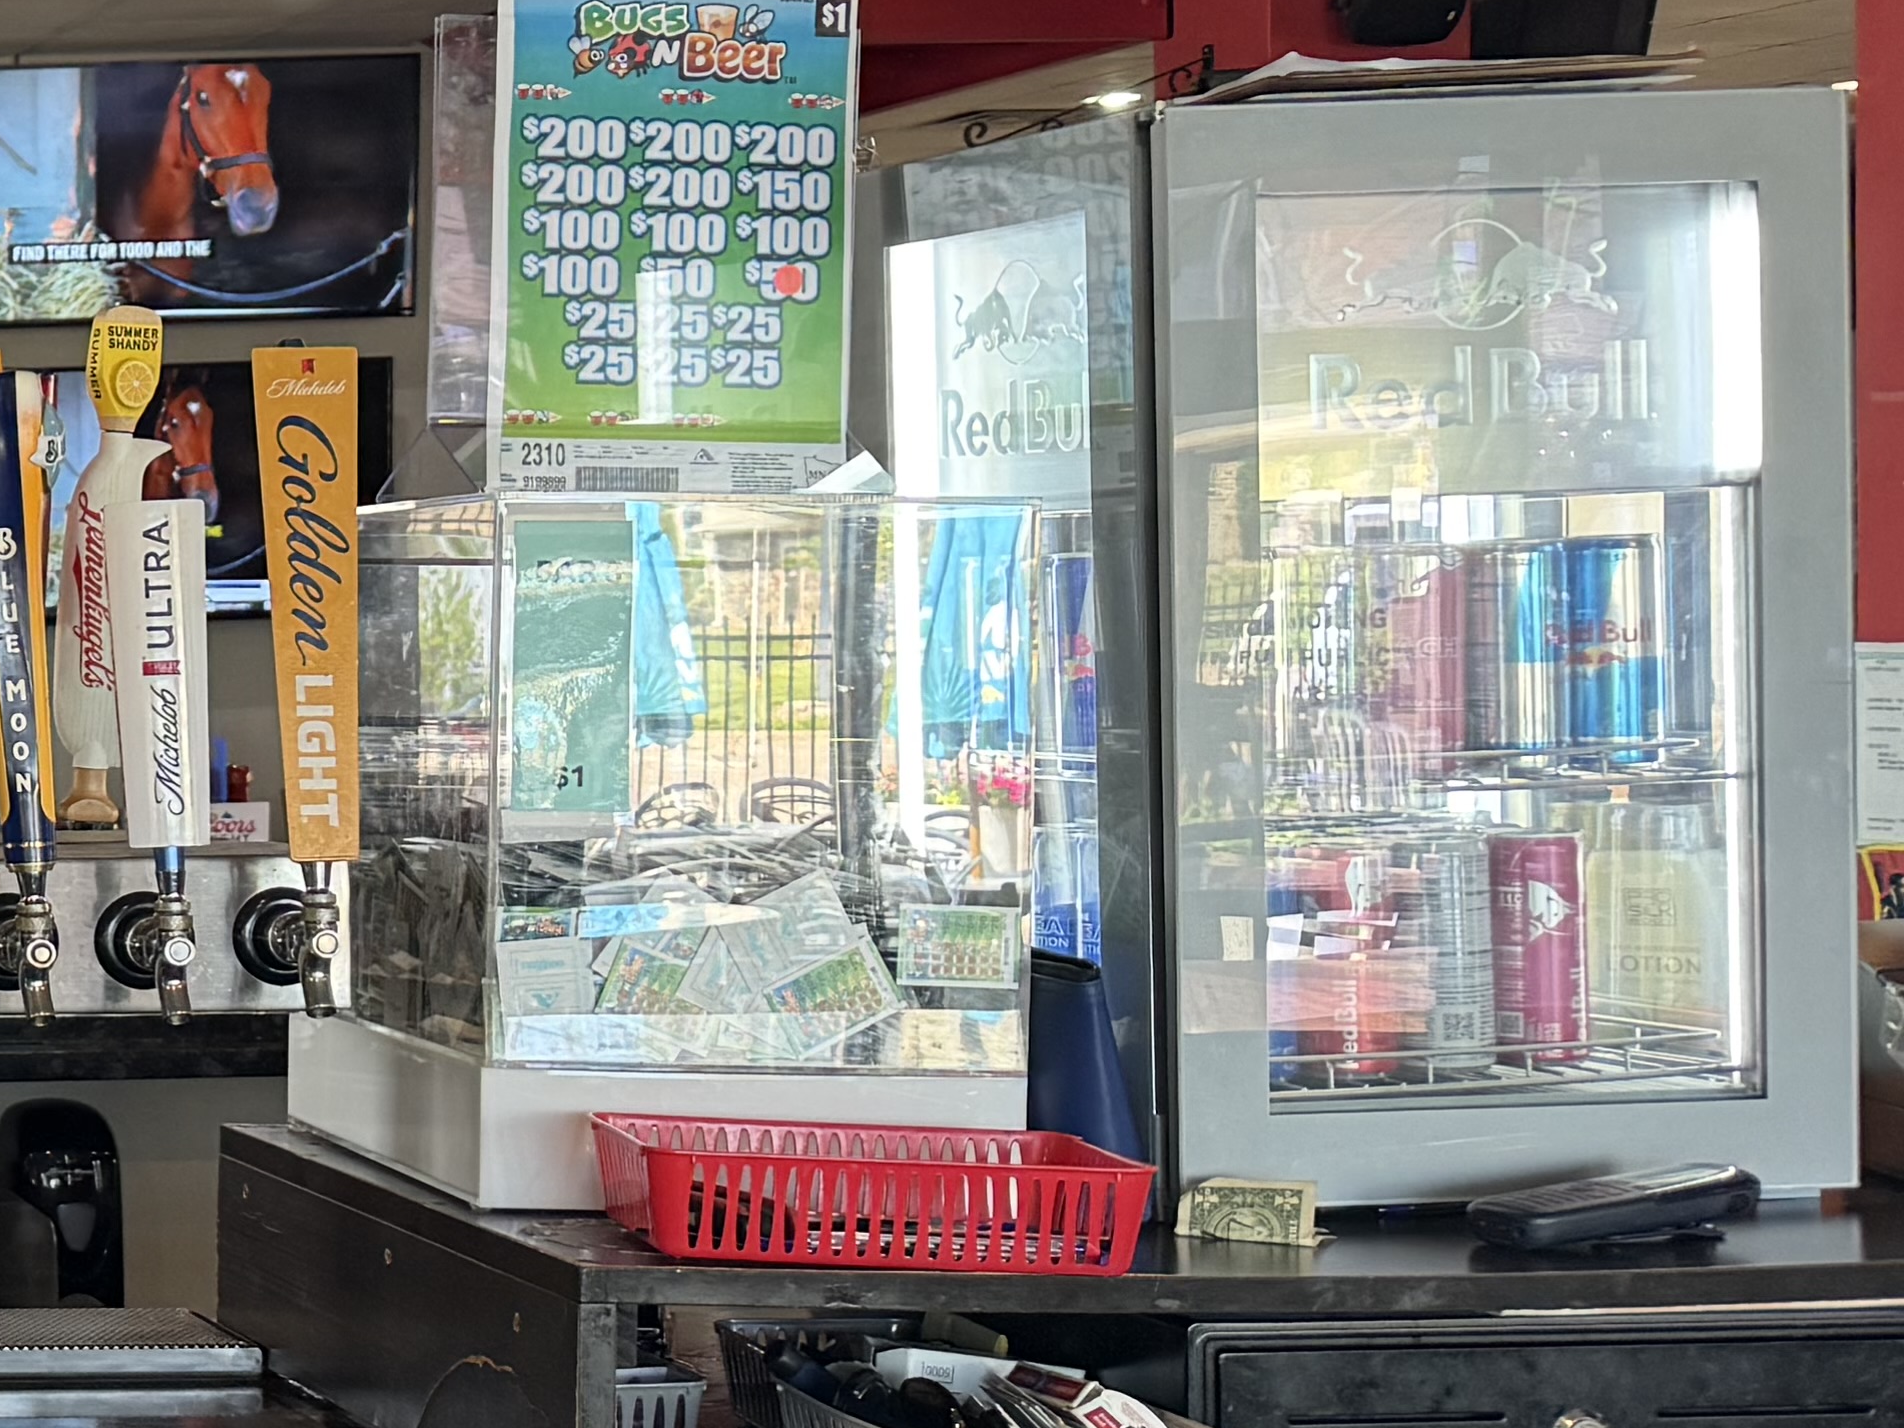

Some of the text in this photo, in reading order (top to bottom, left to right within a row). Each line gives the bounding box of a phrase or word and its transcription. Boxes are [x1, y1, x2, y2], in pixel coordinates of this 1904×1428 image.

[580, 0, 689, 39] BUGS
[822, 2, 846, 32] $1
[651, 34, 786, 81] N Beer
[521, 115, 835, 166] $200 $200 $200
[737, 169, 832, 212] $150
[12, 244, 45, 261] FIND
[185, 240, 212, 257] THE
[267, 377, 346, 398] Michelob
[521, 443, 565, 466] 2310
[144, 514, 171, 651] ULTRA
[276, 415, 350, 828] Golden LIGHT
[5, 679, 36, 795] MOON
[156, 687, 186, 816] Michelob
